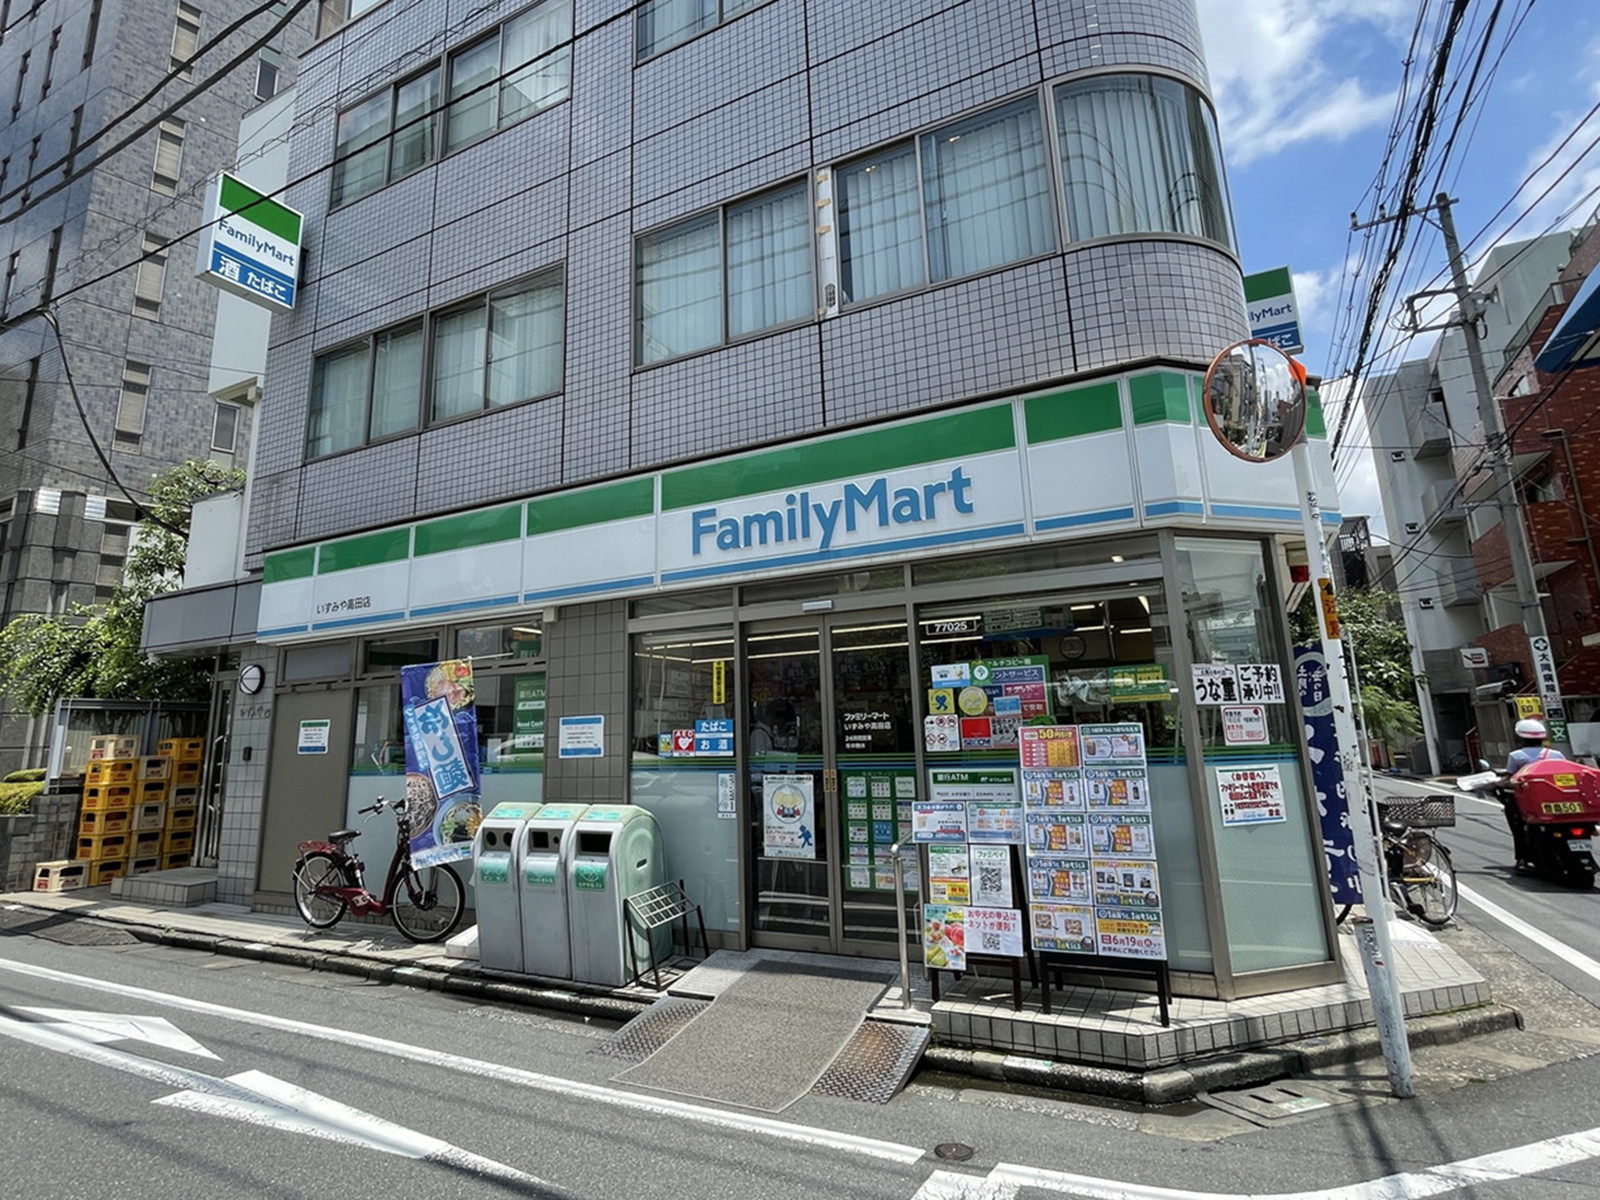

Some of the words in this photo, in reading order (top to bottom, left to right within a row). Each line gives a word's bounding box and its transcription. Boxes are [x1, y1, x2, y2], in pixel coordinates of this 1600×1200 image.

[218, 220, 295, 267] FamilyMart
[218, 256, 241, 281] 酒
[246, 271, 287, 300] たばこ
[1266, 334, 1294, 346] ばこ
[691, 465, 975, 552] FamilyMart
[934, 622, 967, 633] 77025
[1240, 666, 1278, 682] ご予約
[1538, 653, 1557, 693] 大同病院
[1196, 677, 1237, 701] うな重
[844, 712, 889, 721] ファミリーマート
[701, 722, 727, 732] たばこ
[937, 773, 969, 781] 銀行ATM
[977, 850, 1004, 858] ファミペイ
[968, 910, 1017, 920] お中元の申込は
